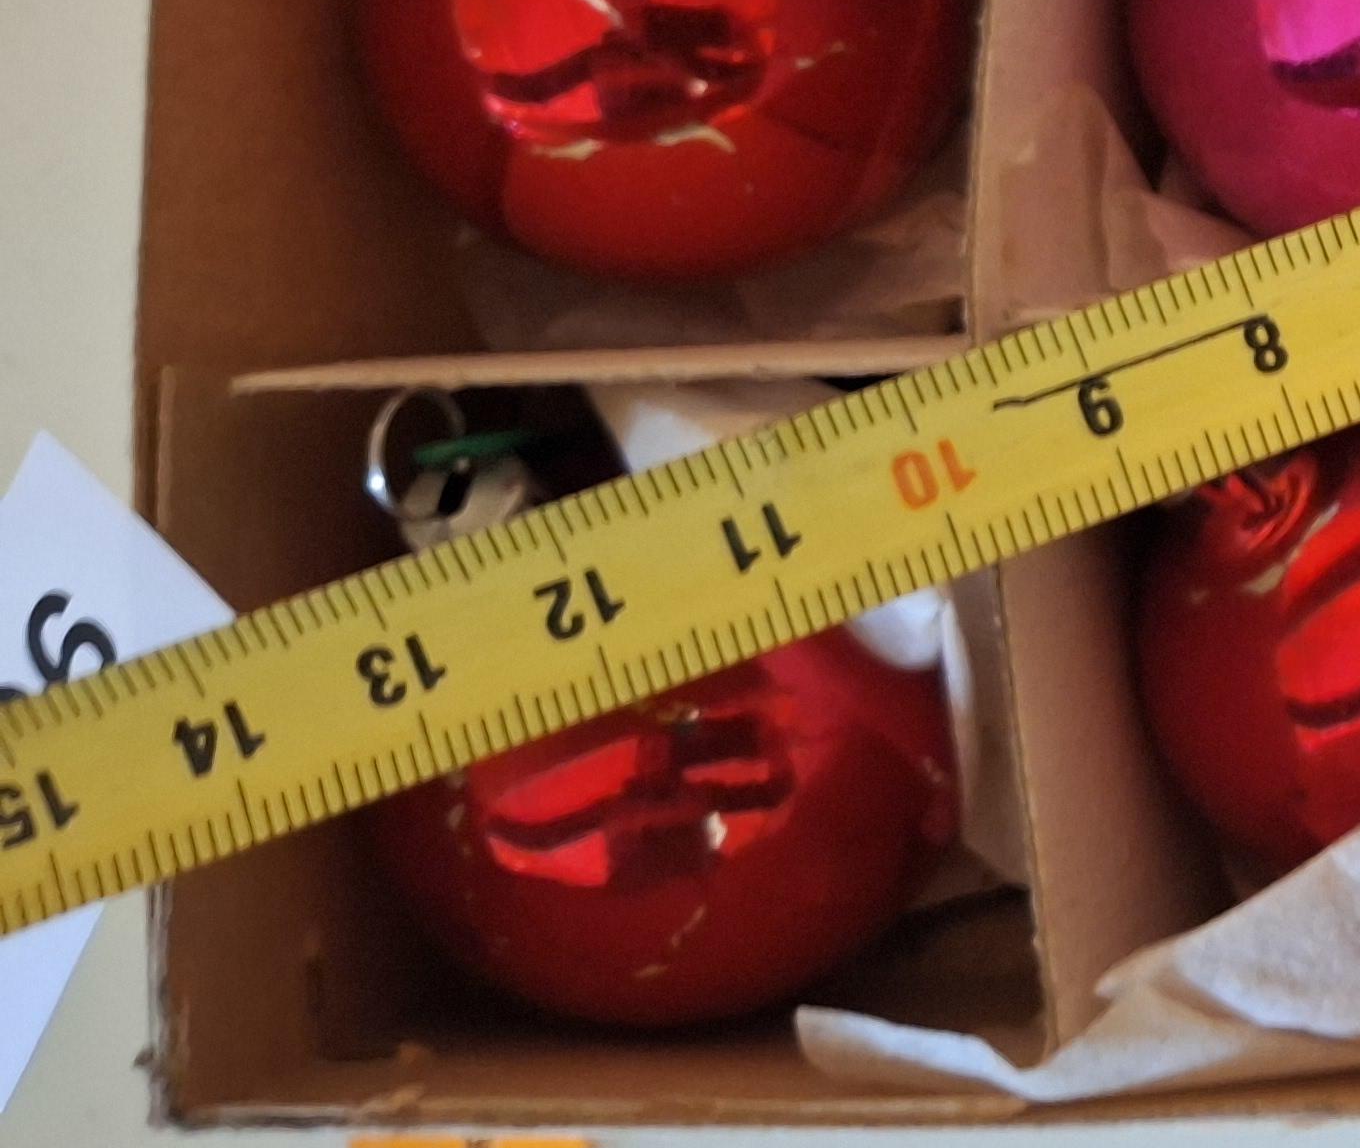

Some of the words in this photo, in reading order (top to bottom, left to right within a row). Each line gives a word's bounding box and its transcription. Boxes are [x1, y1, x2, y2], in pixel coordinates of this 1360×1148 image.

[1243, 316, 1290, 375] 8
[1077, 377, 1125, 438] 9
[890, 439, 977, 512] 10
[720, 502, 802, 574] 11
[532, 568, 625, 641] 12
[355, 633, 447, 708] 13
[172, 700, 266, 779] 14
[0, 770, 78, 850] 15
